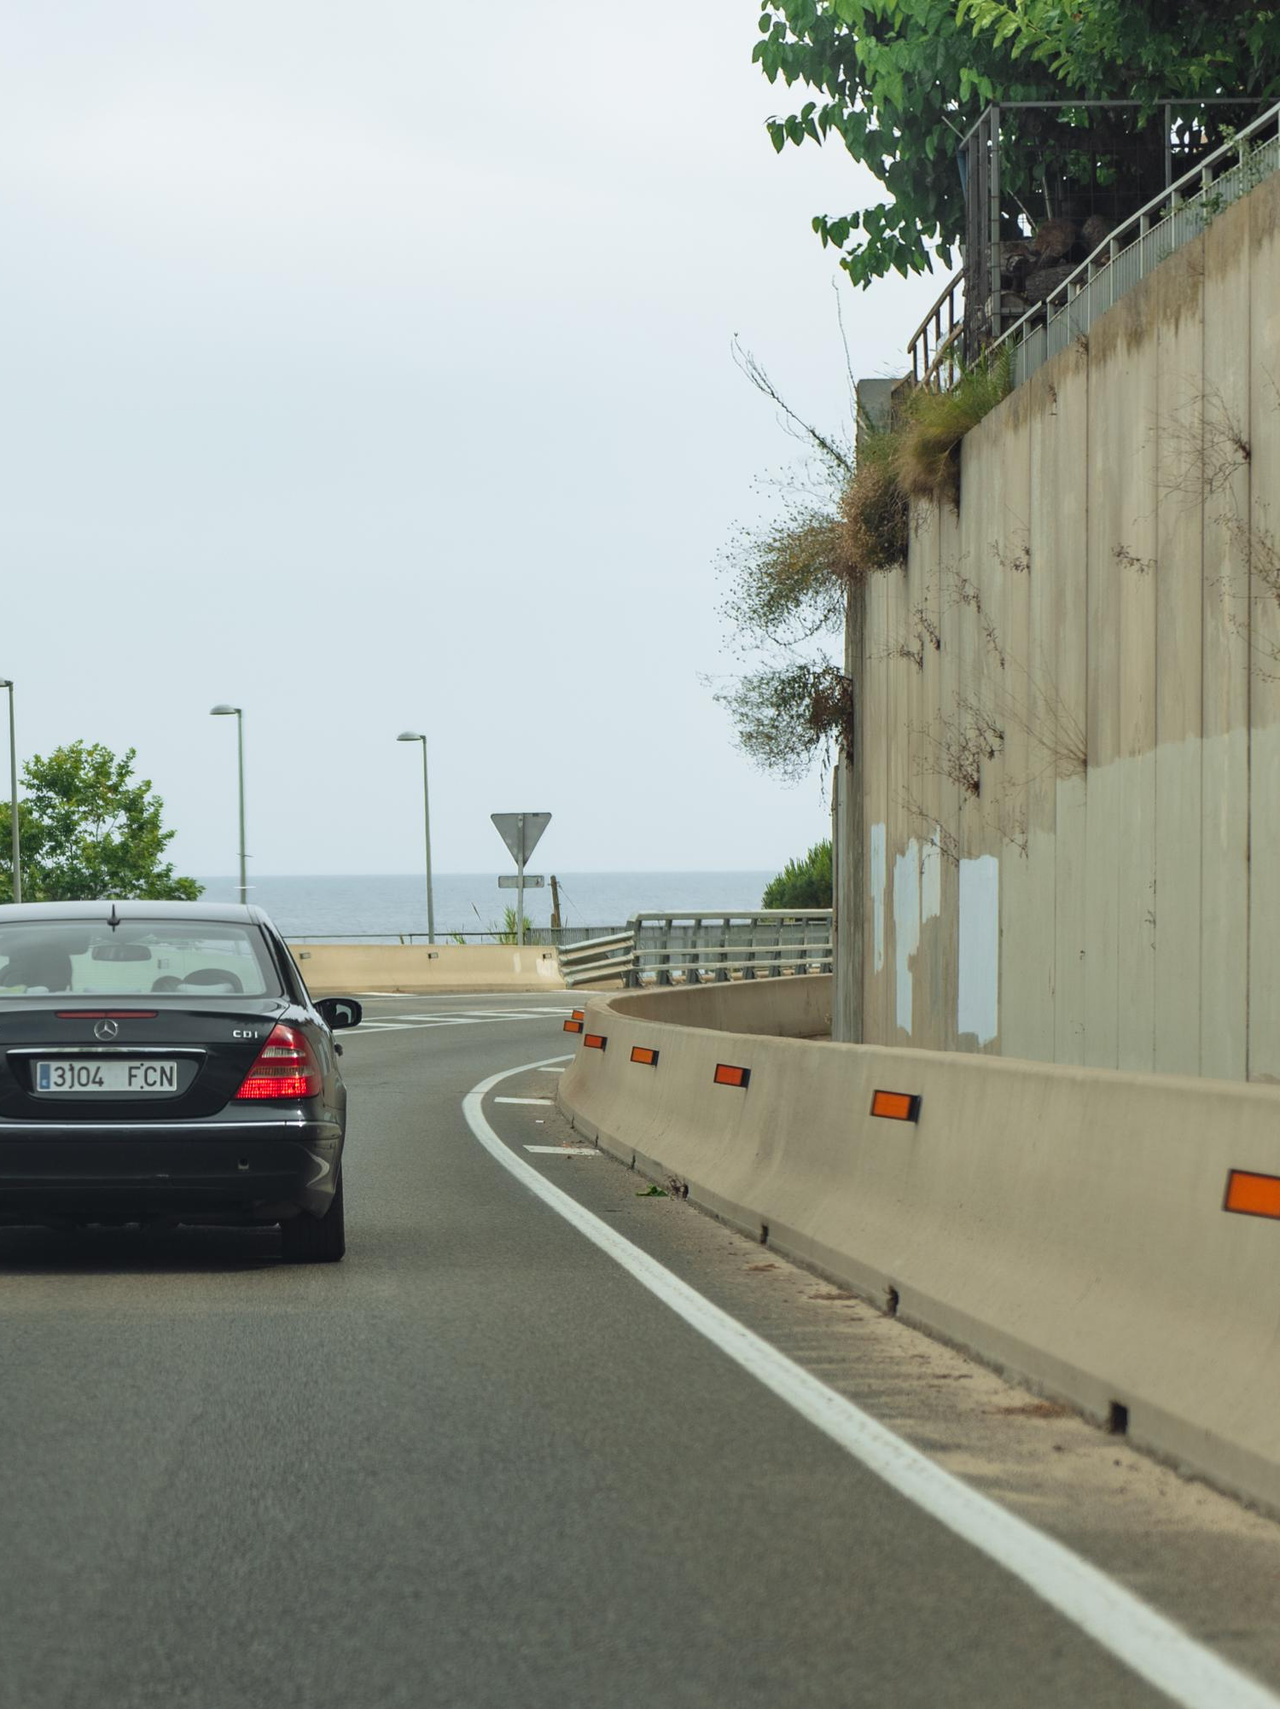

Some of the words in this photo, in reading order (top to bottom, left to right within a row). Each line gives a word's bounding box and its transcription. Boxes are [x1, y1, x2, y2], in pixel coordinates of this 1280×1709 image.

[232, 1030, 258, 1039] CDI
[53, 1065, 104, 1088] 3104
[128, 1065, 174, 1087] FCN
